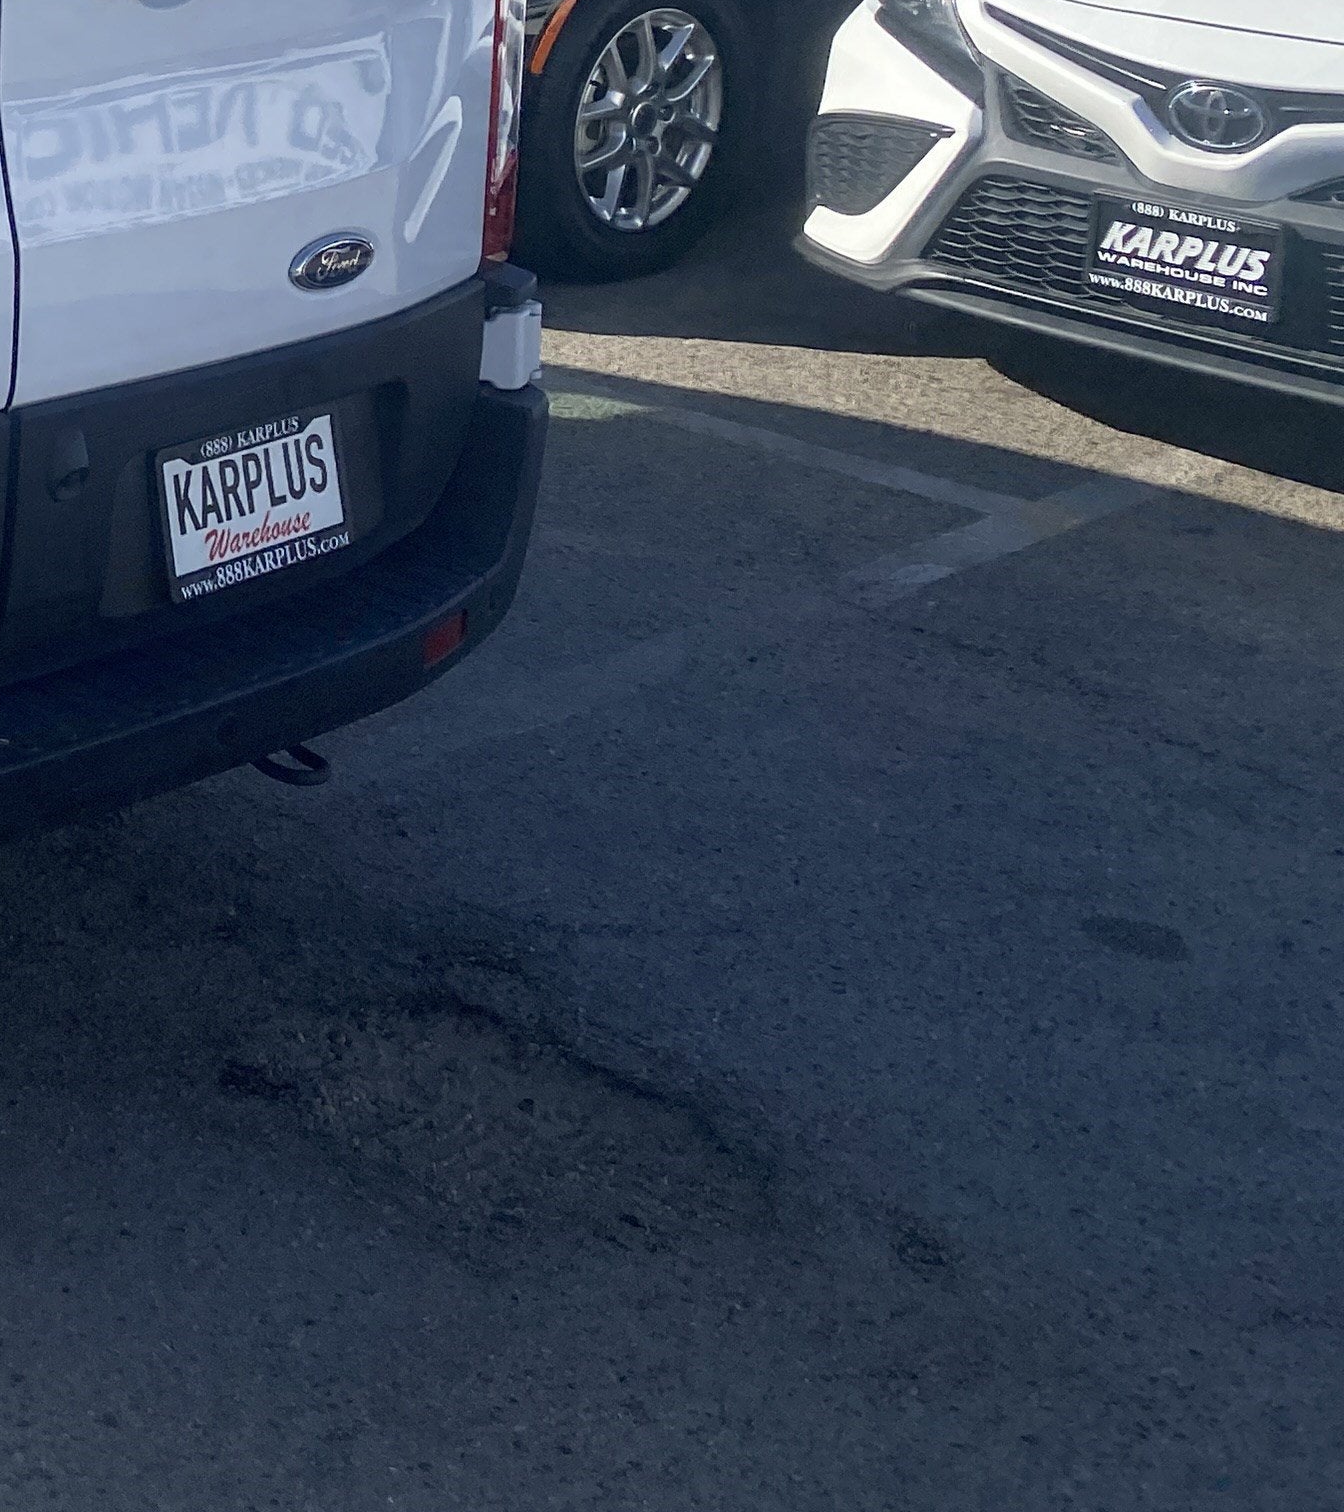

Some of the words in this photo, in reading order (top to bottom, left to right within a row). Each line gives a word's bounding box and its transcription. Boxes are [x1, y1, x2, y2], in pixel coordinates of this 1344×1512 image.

[1130, 201, 1165, 219] (888)
[1168, 208, 1237, 233] KARPLUS
[1097, 250, 1227, 289] WAREHOUSE
[1231, 280, 1269, 297] INC
[1099, 220, 1272, 282] KARPLUS
[199, 434, 234, 458] (888)
[235, 415, 302, 448] KARPLUS
[172, 432, 329, 536] KARPLUS
[204, 509, 312, 561] Warehouse
